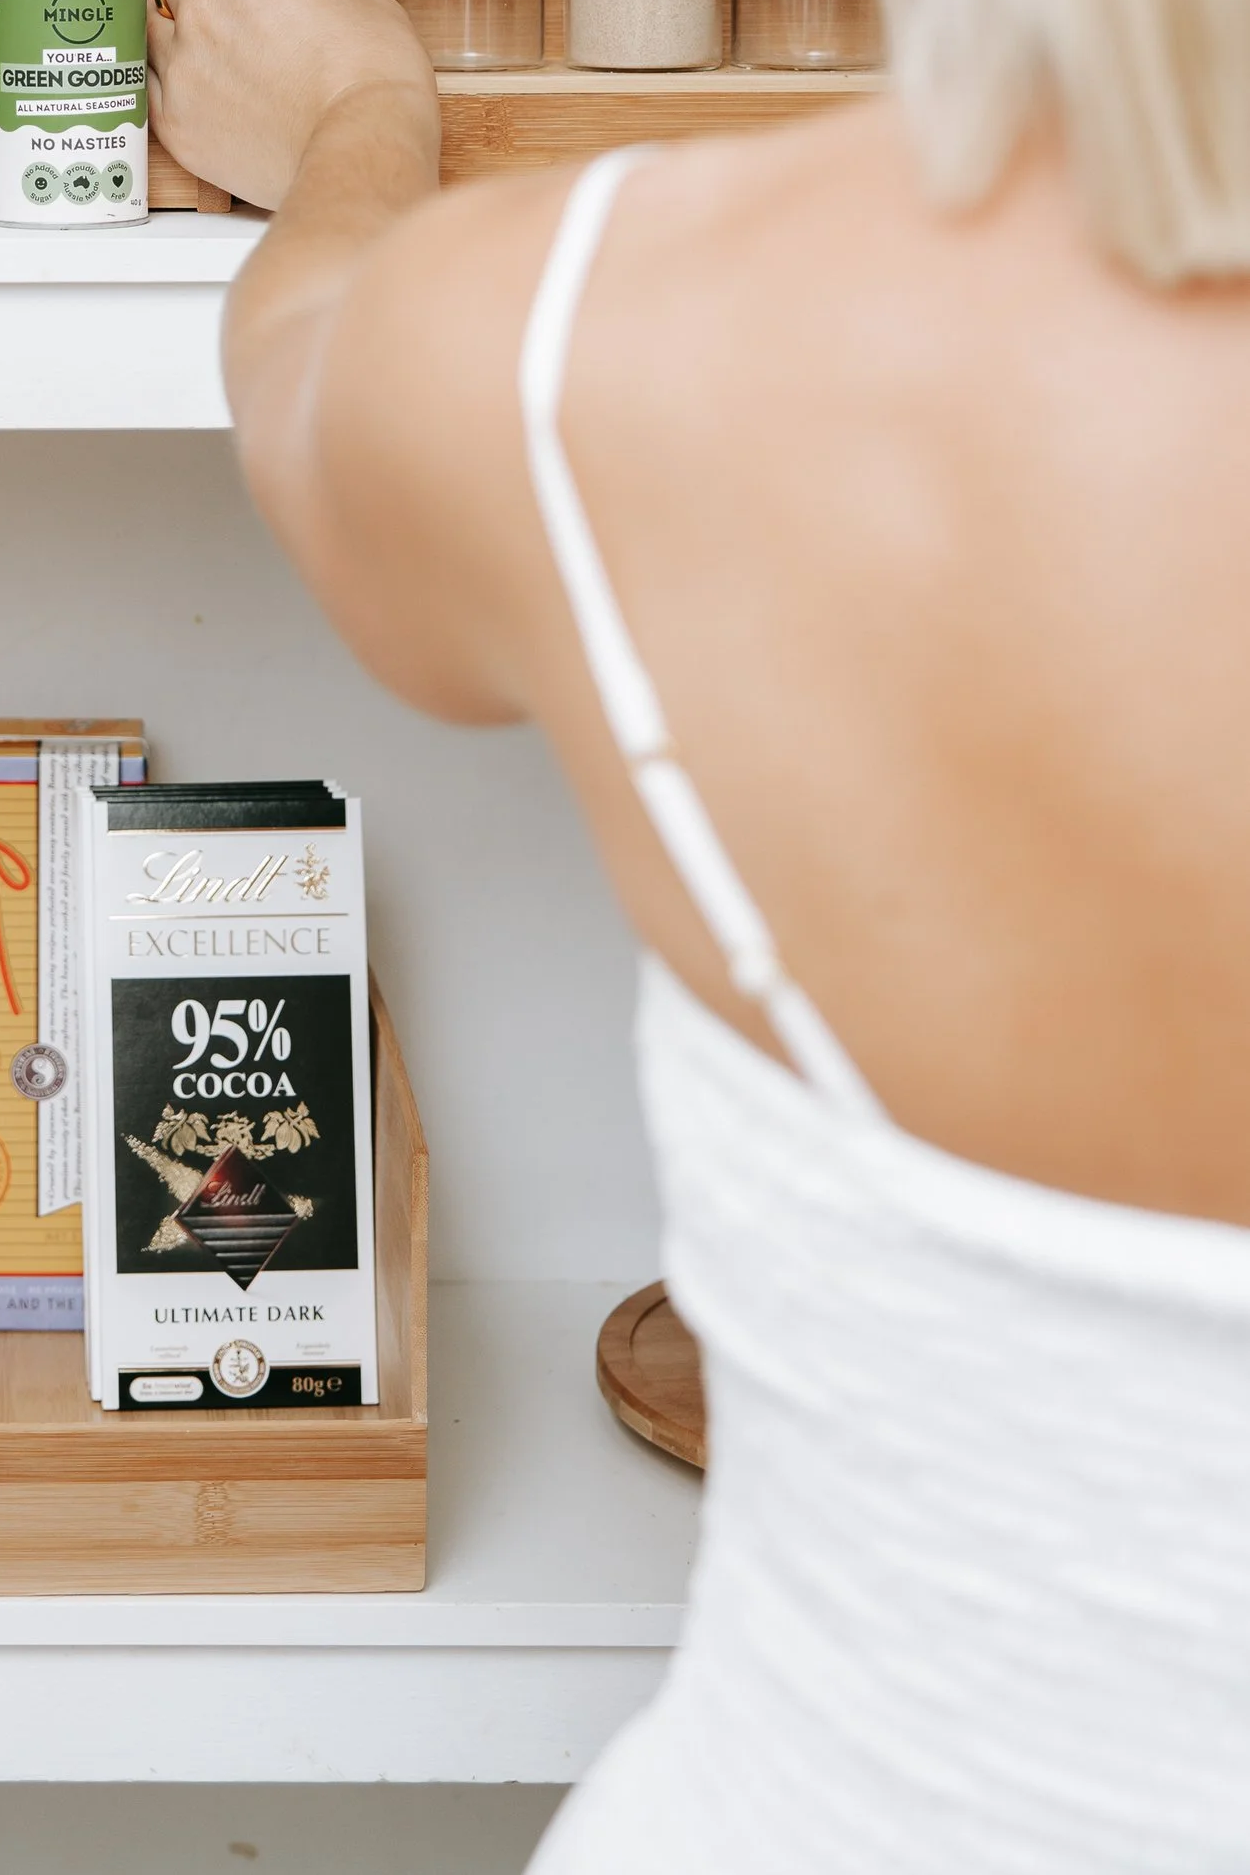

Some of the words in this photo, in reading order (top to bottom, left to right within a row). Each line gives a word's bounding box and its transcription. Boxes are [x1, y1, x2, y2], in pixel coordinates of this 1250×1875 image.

[44, 7, 113, 21] MINGLE
[47, 53, 92, 63] YOU'RE
[96, 53, 112, 62] A...
[3, 70, 63, 87] GREEN
[68, 67, 144, 87] GODDESS
[18, 102, 33, 111] ALL
[37, 101, 83, 111] NATURAL
[86, 98, 135, 110] SEASONING
[31, 138, 55, 150] NO
[62, 136, 126, 150] NASTIES
[125, 849, 289, 902] Lindt
[128, 927, 331, 957] EXCELLENCE
[171, 999, 292, 1069] 95%
[172, 1072, 297, 1099] COCOA
[7, 1298, 39, 1309] AND
[48, 1297, 75, 1309] THE
[154, 1306, 258, 1323] ULTIMATE
[268, 1305, 324, 1321] DARK
[292, 1376, 325, 1396] 80g
